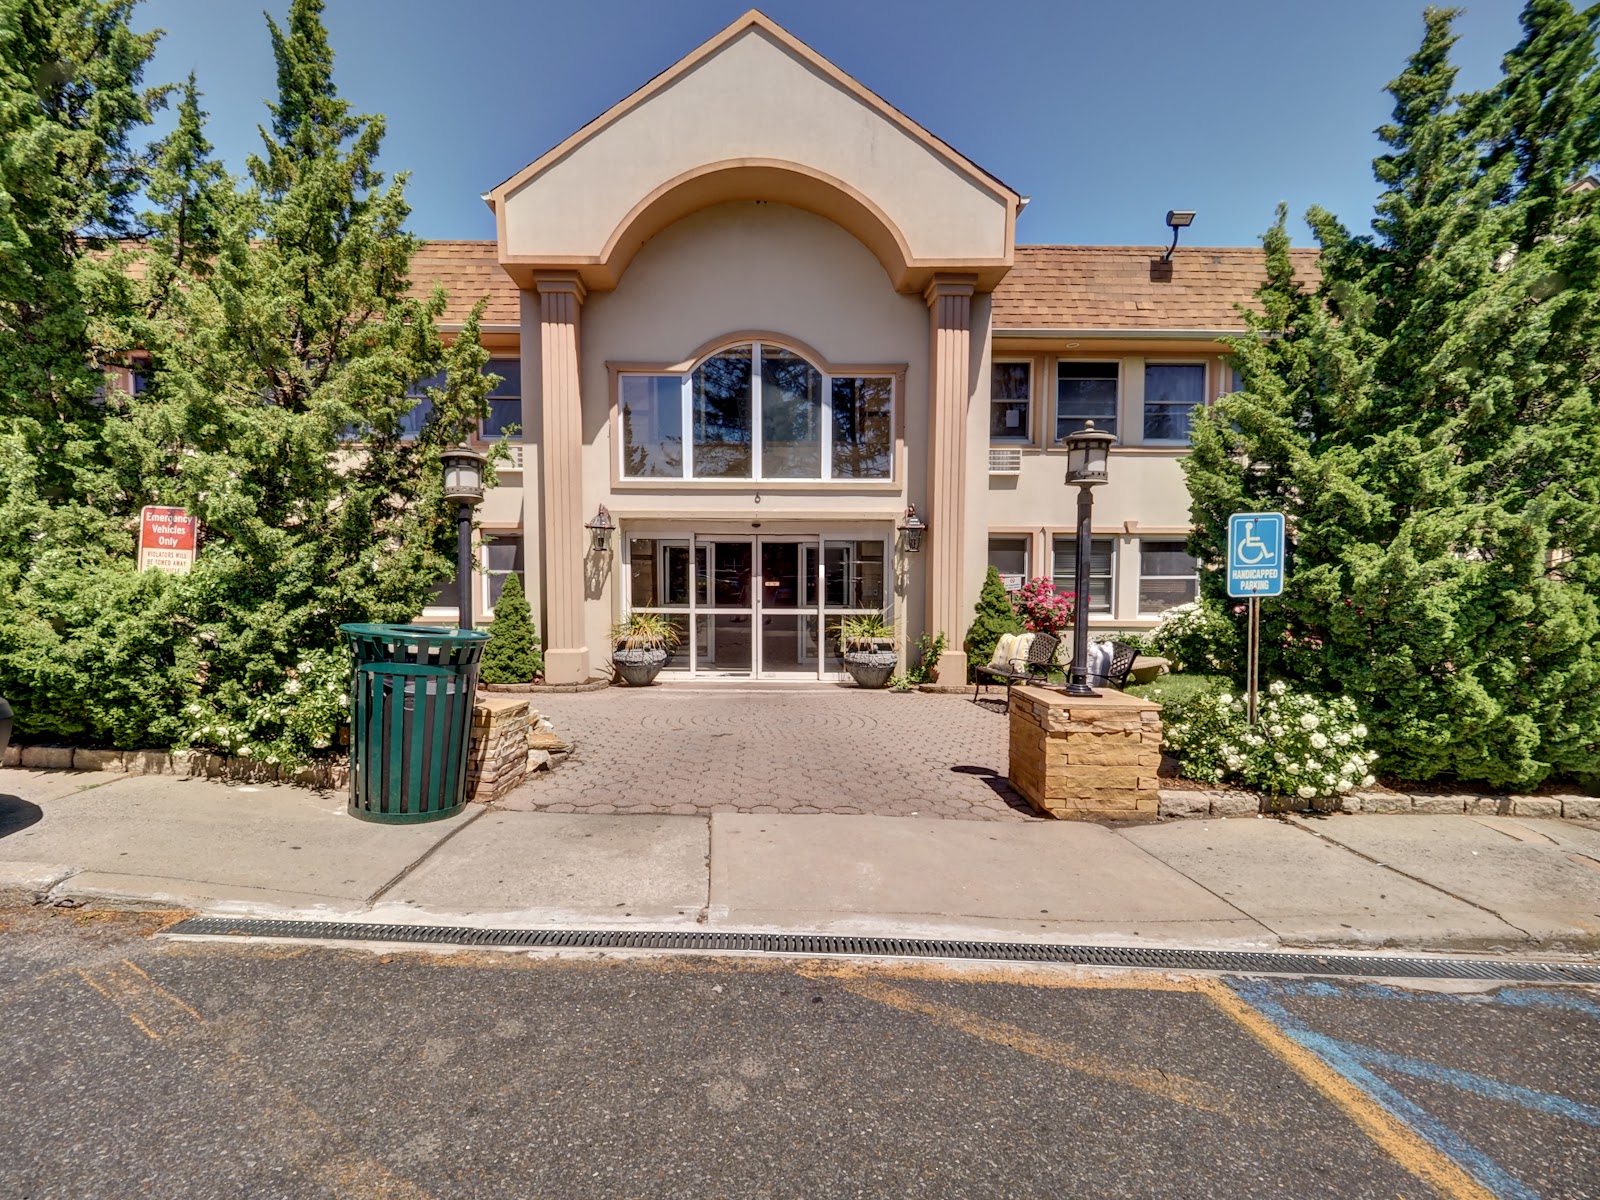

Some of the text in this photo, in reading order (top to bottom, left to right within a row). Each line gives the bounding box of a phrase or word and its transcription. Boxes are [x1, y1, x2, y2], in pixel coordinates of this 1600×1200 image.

[146, 512, 192, 525] Emergency
[152, 524, 186, 535] Vehicles
[158, 536, 178, 548] Only
[1232, 569, 1278, 579] HANDICAPPED
[1240, 580, 1269, 590] PARKING
